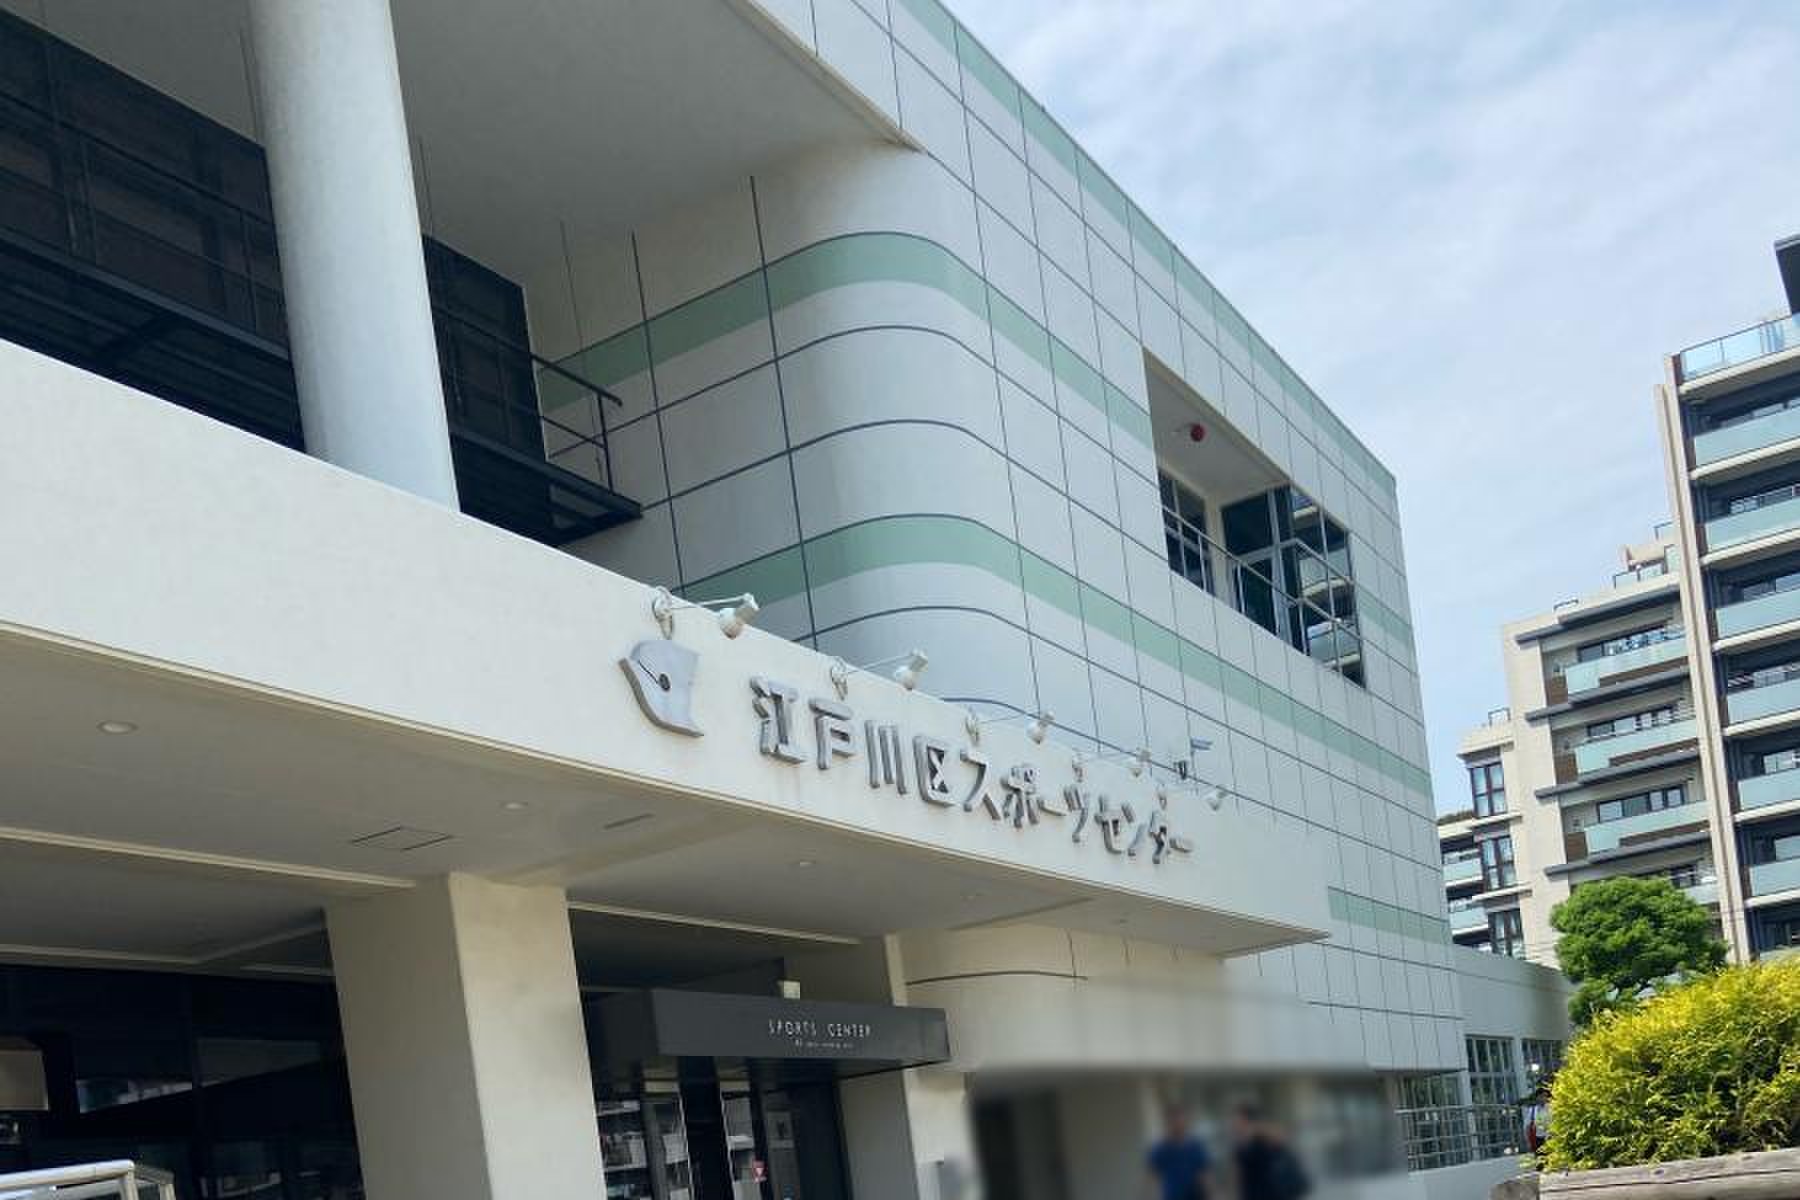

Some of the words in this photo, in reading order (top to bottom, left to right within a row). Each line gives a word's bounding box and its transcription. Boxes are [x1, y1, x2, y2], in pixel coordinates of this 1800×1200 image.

[749, 676, 1192, 864] 江戸川区スポーツセンター
[768, 1018, 817, 1036] SPORTS
[827, 1022, 871, 1038] CENTER
